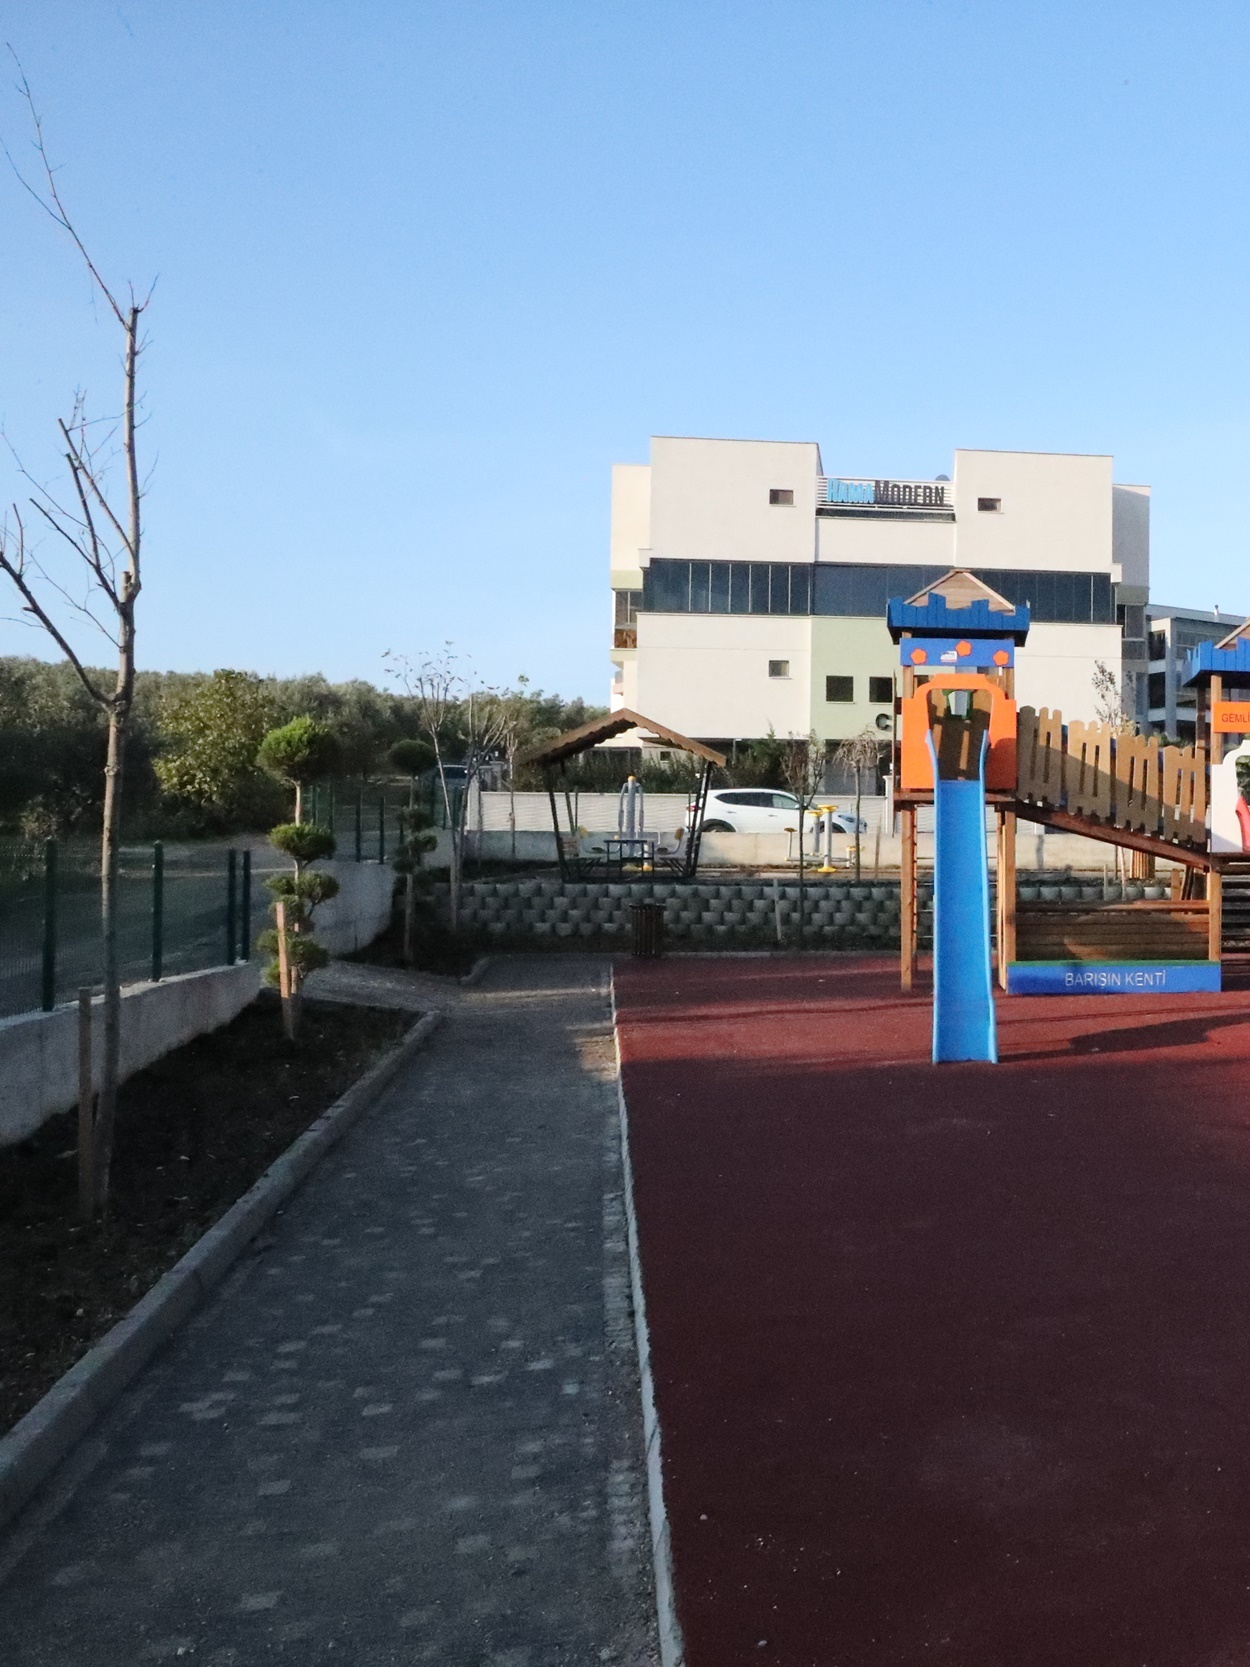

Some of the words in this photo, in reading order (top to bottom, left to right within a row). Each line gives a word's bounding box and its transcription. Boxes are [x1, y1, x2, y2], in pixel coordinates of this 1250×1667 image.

[874, 480, 945, 505] MODERN
[875, 713, 893, 732] C
[1064, 972, 1121, 988] BARIŞIN
[1125, 970, 1166, 986] KENTİ
